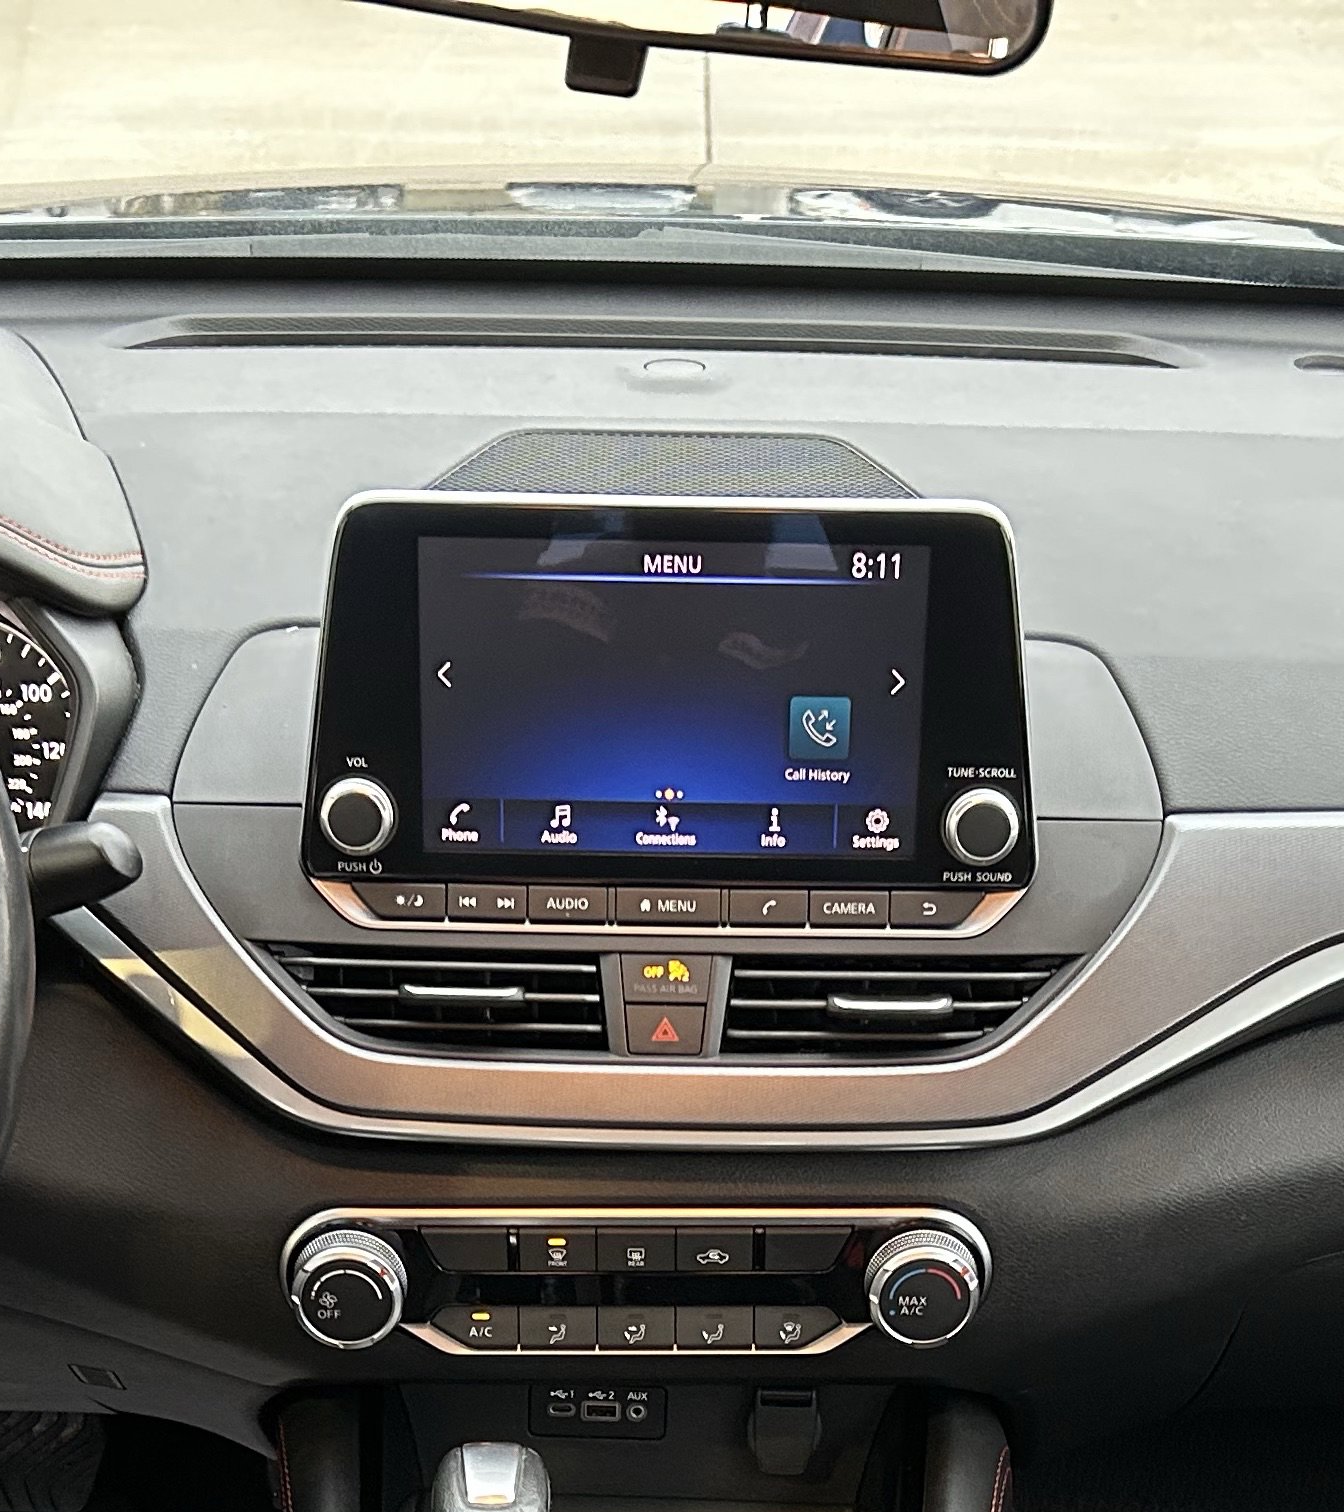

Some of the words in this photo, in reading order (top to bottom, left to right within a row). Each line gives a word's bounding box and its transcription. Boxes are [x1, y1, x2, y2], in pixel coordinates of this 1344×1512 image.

[643, 554, 703, 574] MENU
[851, 552, 901, 580] 8:11
[20, 683, 52, 703] 100
[346, 757, 368, 768] VOL
[784, 768, 806, 781] Call
[807, 768, 851, 784] History
[442, 828, 479, 842] Phone
[541, 830, 577, 844] Audio
[635, 832, 697, 847] Connections
[760, 834, 786, 848] Info
[852, 835, 900, 852] Settings
[337, 861, 366, 872] PUSH
[943, 872, 972, 882] PUSH
[976, 872, 1013, 882] SOUND
[547, 897, 588, 910] AUDIO
[657, 899, 697, 913] MENU
[823, 902, 875, 914] CAMERA
[643, 965, 665, 979] OFF
[634, 984, 658, 993] PASS
[659, 984, 676, 994] AIR
[678, 985, 698, 995] BAG
[898, 1296, 927, 1306] MAX
[317, 1310, 342, 1320] OFF
[900, 1306, 923, 1316] A/C
[469, 1326, 493, 1338] A/C
[608, 1390, 615, 1400] 2
[627, 1391, 648, 1401] AUX
